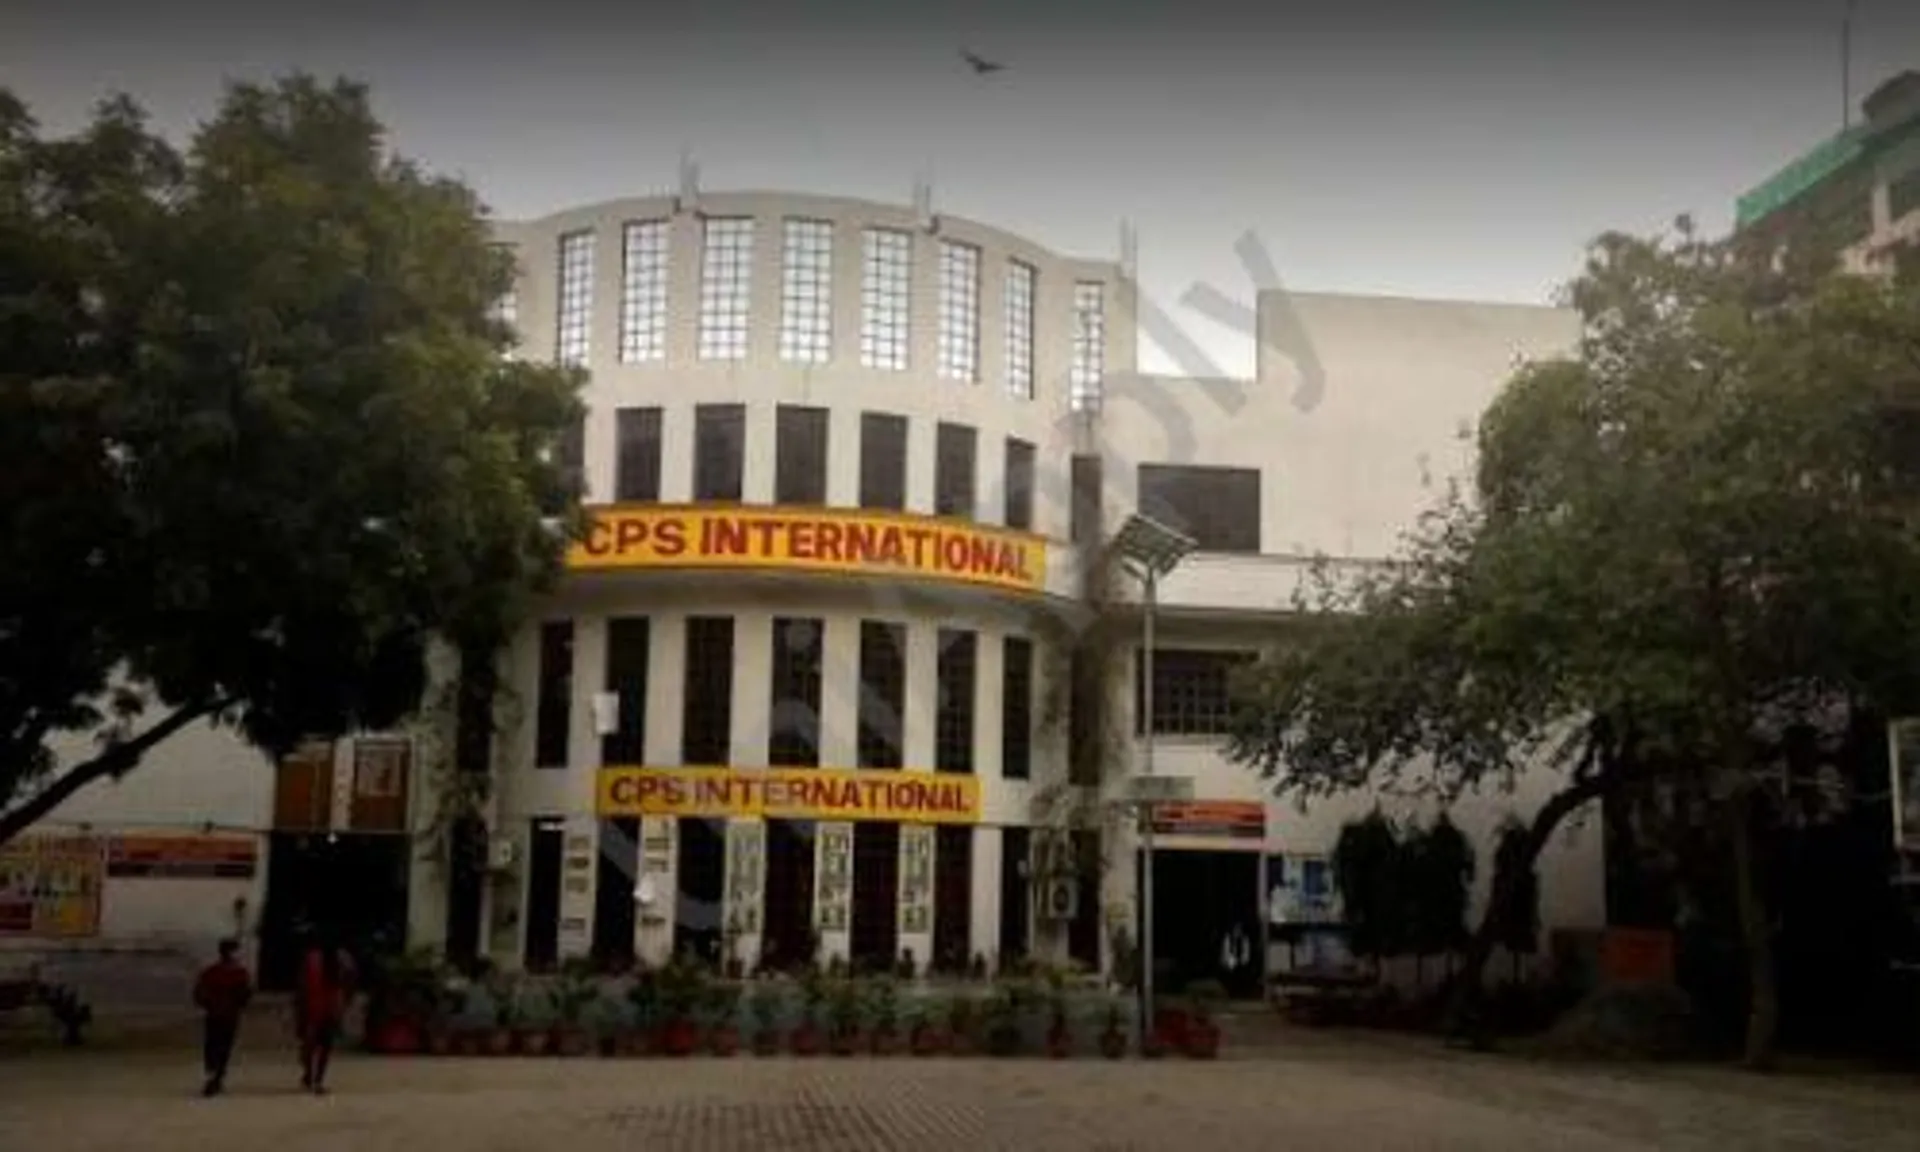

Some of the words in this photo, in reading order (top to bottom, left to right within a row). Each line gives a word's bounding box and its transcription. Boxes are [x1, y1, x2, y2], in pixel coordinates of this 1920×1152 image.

[583, 518, 687, 556] CPS
[700, 518, 1032, 581] INTERNATIONAL
[610, 775, 686, 806] CPS
[695, 776, 973, 815] INTERNATIONAL
